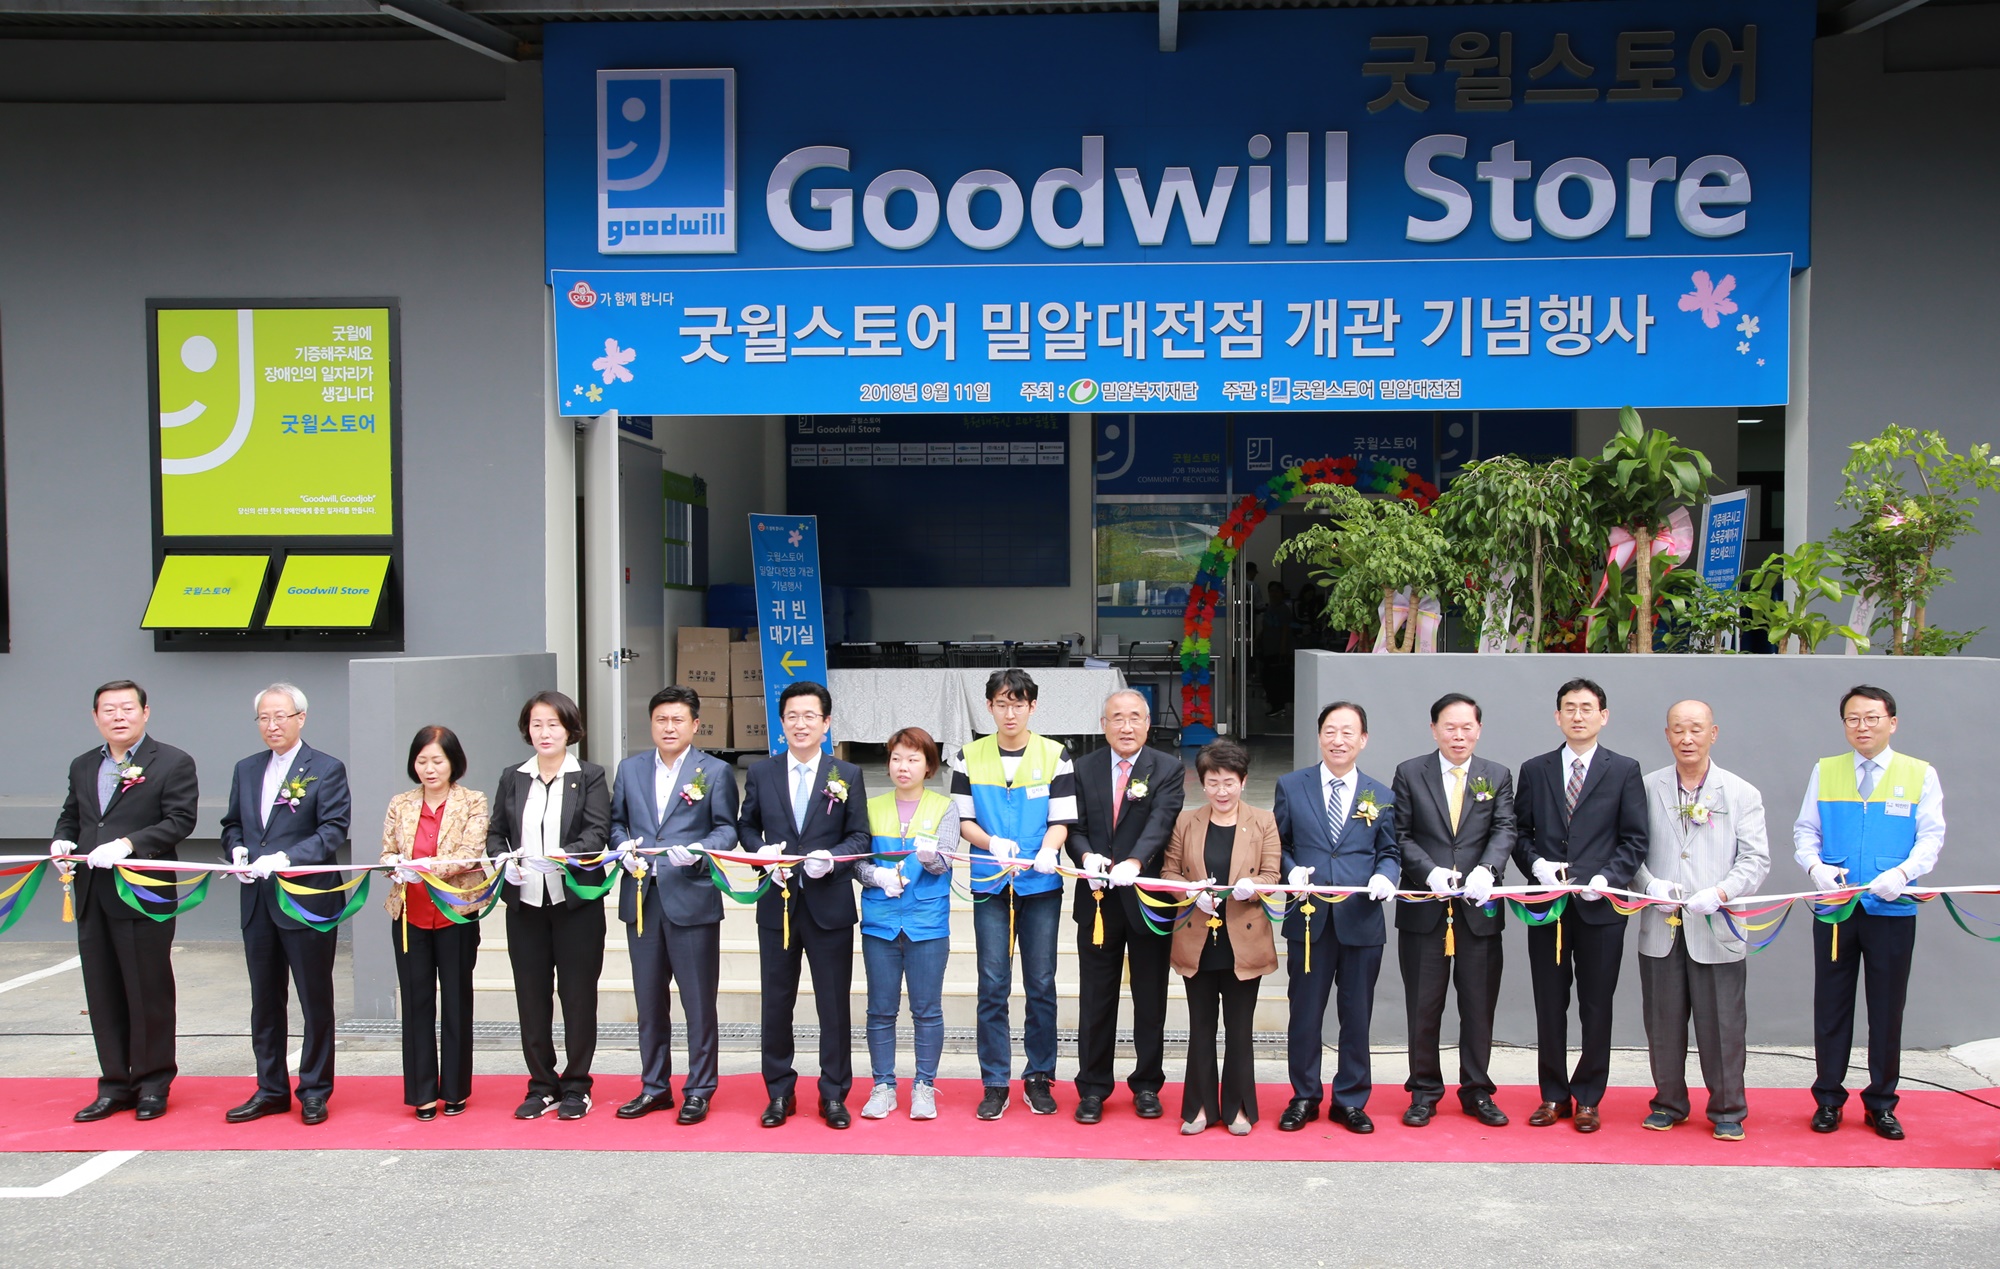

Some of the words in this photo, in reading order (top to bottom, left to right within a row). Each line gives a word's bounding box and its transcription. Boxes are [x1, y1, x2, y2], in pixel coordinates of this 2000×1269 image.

[1362, 24, 1757, 113] 굿윌스토어
[766, 130, 1348, 251] Goodwill
[1404, 133, 1752, 242] Store
[607, 213, 725, 246] goodwill
[600, 292, 612, 306] 가
[614, 292, 636, 306] 함께
[640, 292, 674, 306] 합니다
[332, 325, 372, 341] 굿윌에
[679, 302, 956, 363] 굿윌스토어
[982, 299, 1262, 360] 밀알대전점
[1285, 297, 1401, 358] 개관
[1420, 294, 1654, 356] 기념행사
[295, 346, 374, 362] 기증해주세요
[264, 366, 316, 382] 장애인의
[321, 366, 374, 382] 일자리가
[321, 386, 374, 402] 생깁니다
[860, 383, 917, 402] 2018년
[922, 383, 949, 402] 9월
[954, 382, 990, 402] 11일
[1102, 382, 1198, 401] 밀알복지재단
[1293, 380, 1374, 400] 굿윌스토어
[1380, 379, 1461, 399] 밀알대전점
[281, 414, 374, 434] 굿윌스토어
[1353, 436, 1417, 450] 굿윌스토어
[767, 552, 804, 562] 굿윌스토어
[760, 566, 796, 576] 밀알대전점
[798, 566, 814, 577] 개관
[183, 587, 231, 595] 굿윌스토어
[287, 586, 337, 594] Goodwill
[340, 586, 370, 594] Store
[772, 581, 802, 592] 기념행사
[770, 625, 814, 645] 대기실
